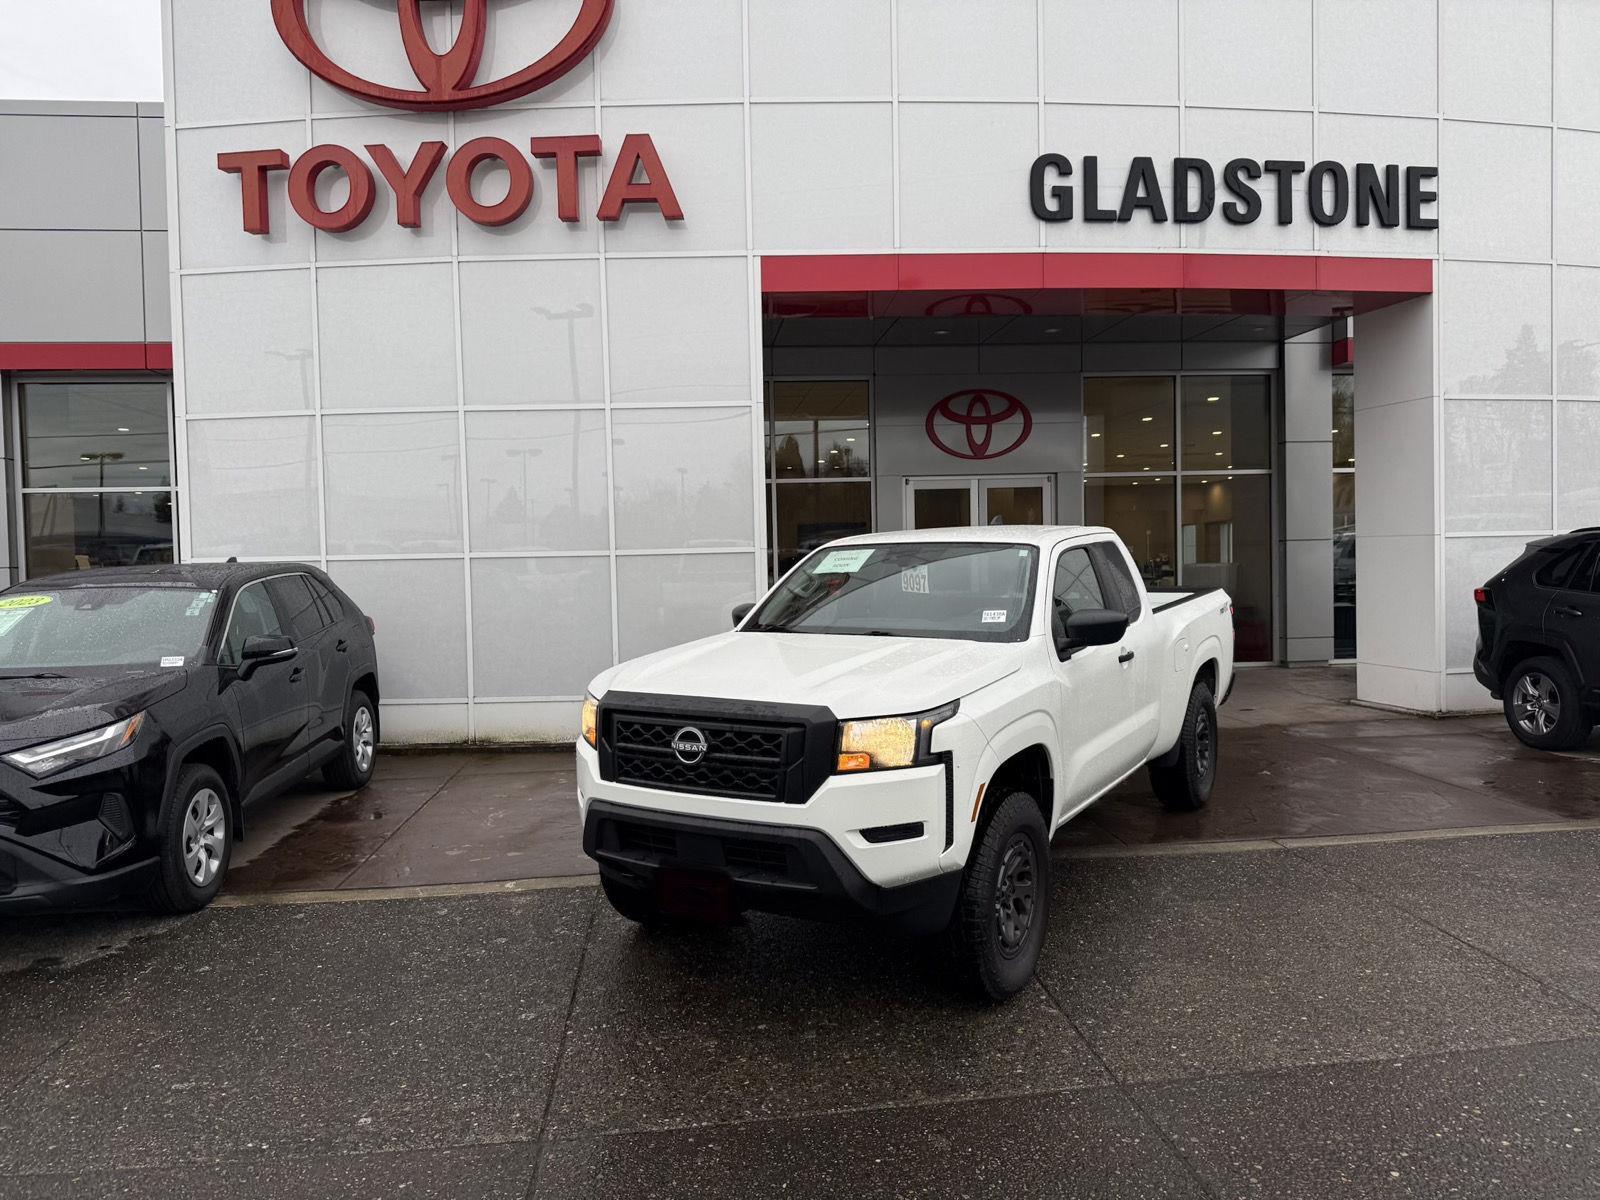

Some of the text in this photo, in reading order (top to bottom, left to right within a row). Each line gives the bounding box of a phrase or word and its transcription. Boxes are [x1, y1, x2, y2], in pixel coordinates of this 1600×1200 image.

[217, 133, 684, 236] TOYOTA
[1029, 153, 1439, 230] GLADSTONE
[902, 574, 927, 593] 9097
[671, 741, 707, 752] NISSAN
